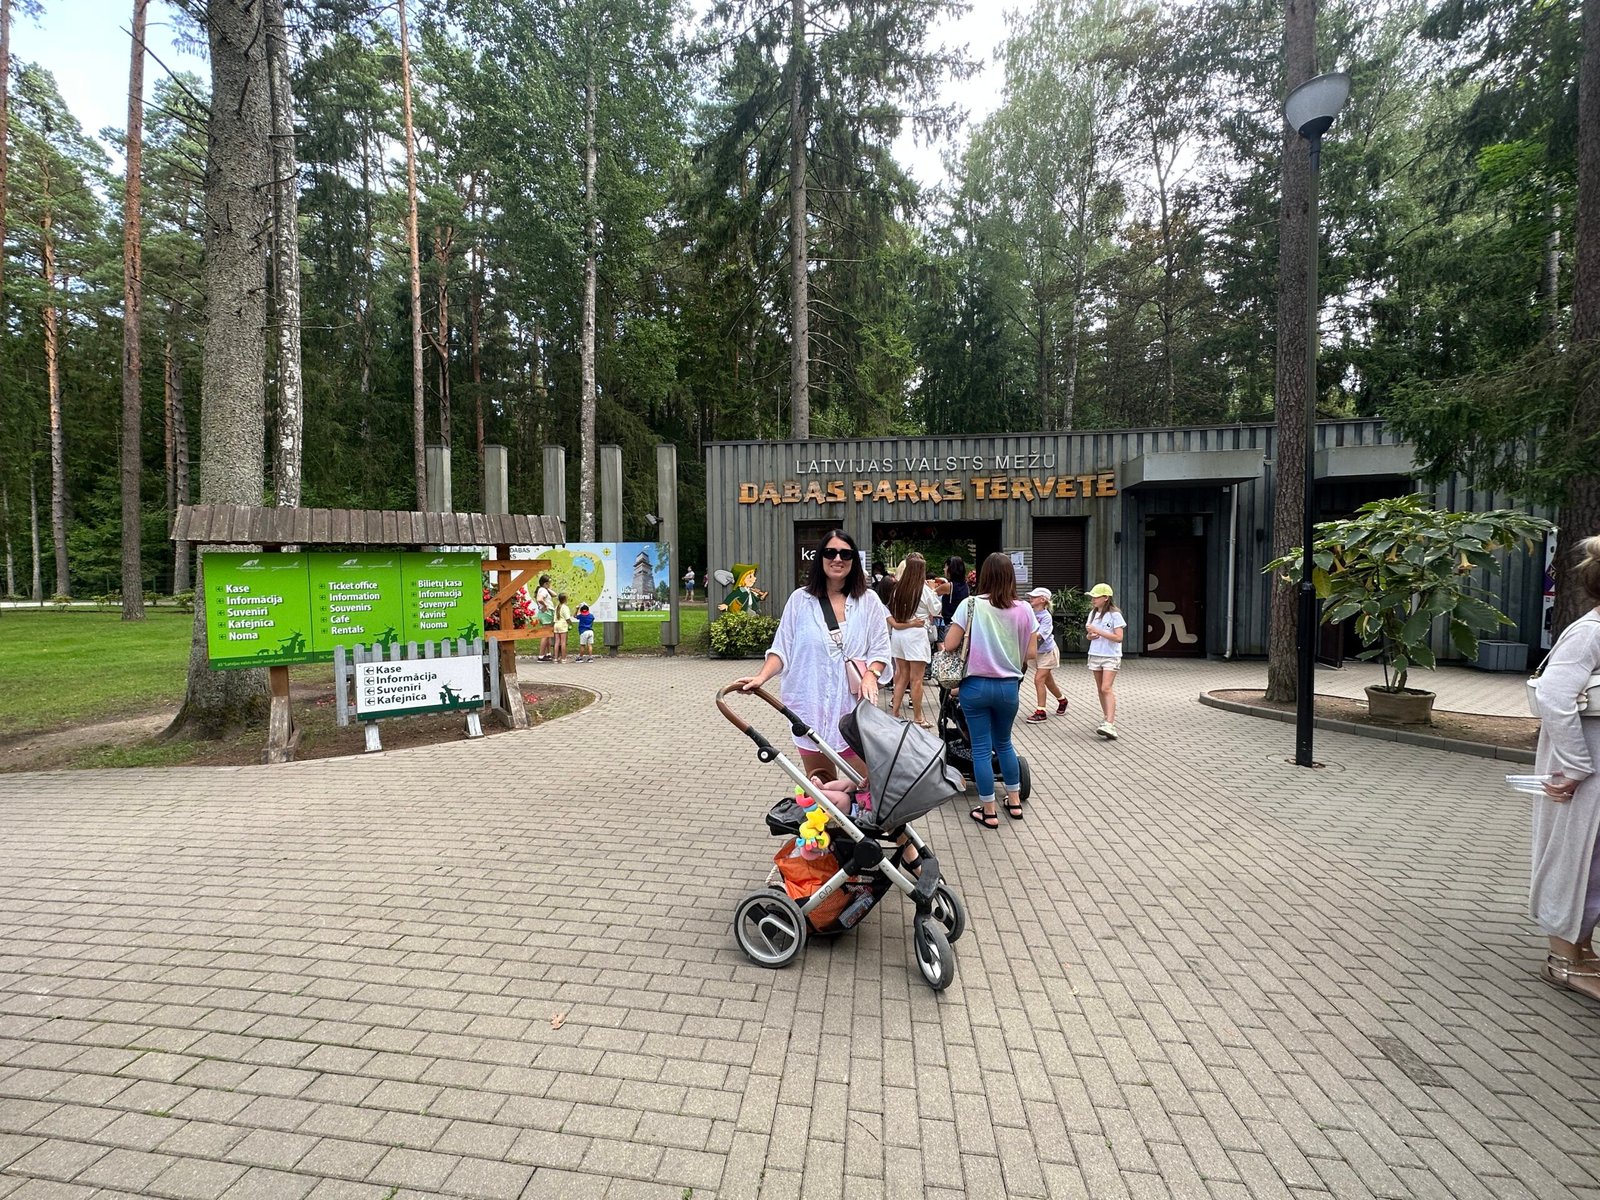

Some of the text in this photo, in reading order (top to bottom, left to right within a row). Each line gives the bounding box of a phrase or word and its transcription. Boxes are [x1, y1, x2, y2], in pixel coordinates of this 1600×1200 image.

[796, 450, 1056, 474] LATVIJAS VALSTS MEŽU
[738, 470, 1118, 506] DABAS PARKS TĒRVETĒ
[328, 580, 378, 591] Ticket office
[445, 579, 463, 587] kasa
[225, 584, 250, 594] Kase
[329, 592, 381, 602] Information
[418, 590, 463, 599] Informacija
[226, 595, 284, 606] Informācija
[419, 600, 457, 610] Suvenyrai
[227, 607, 268, 617] Suvenīri
[330, 603, 373, 613] Souvenirs
[330, 615, 351, 624] Cafe
[420, 611, 447, 619] Kavinė
[228, 619, 275, 630] Kafejnīca
[420, 621, 449, 630] Nuoma
[331, 625, 365, 635] Rentals
[229, 632, 259, 641] Noma
[376, 666, 403, 675] Kase
[376, 672, 438, 685] Informācija
[376, 683, 422, 695] Suvenīri
[377, 694, 428, 706] Kafejnīca
